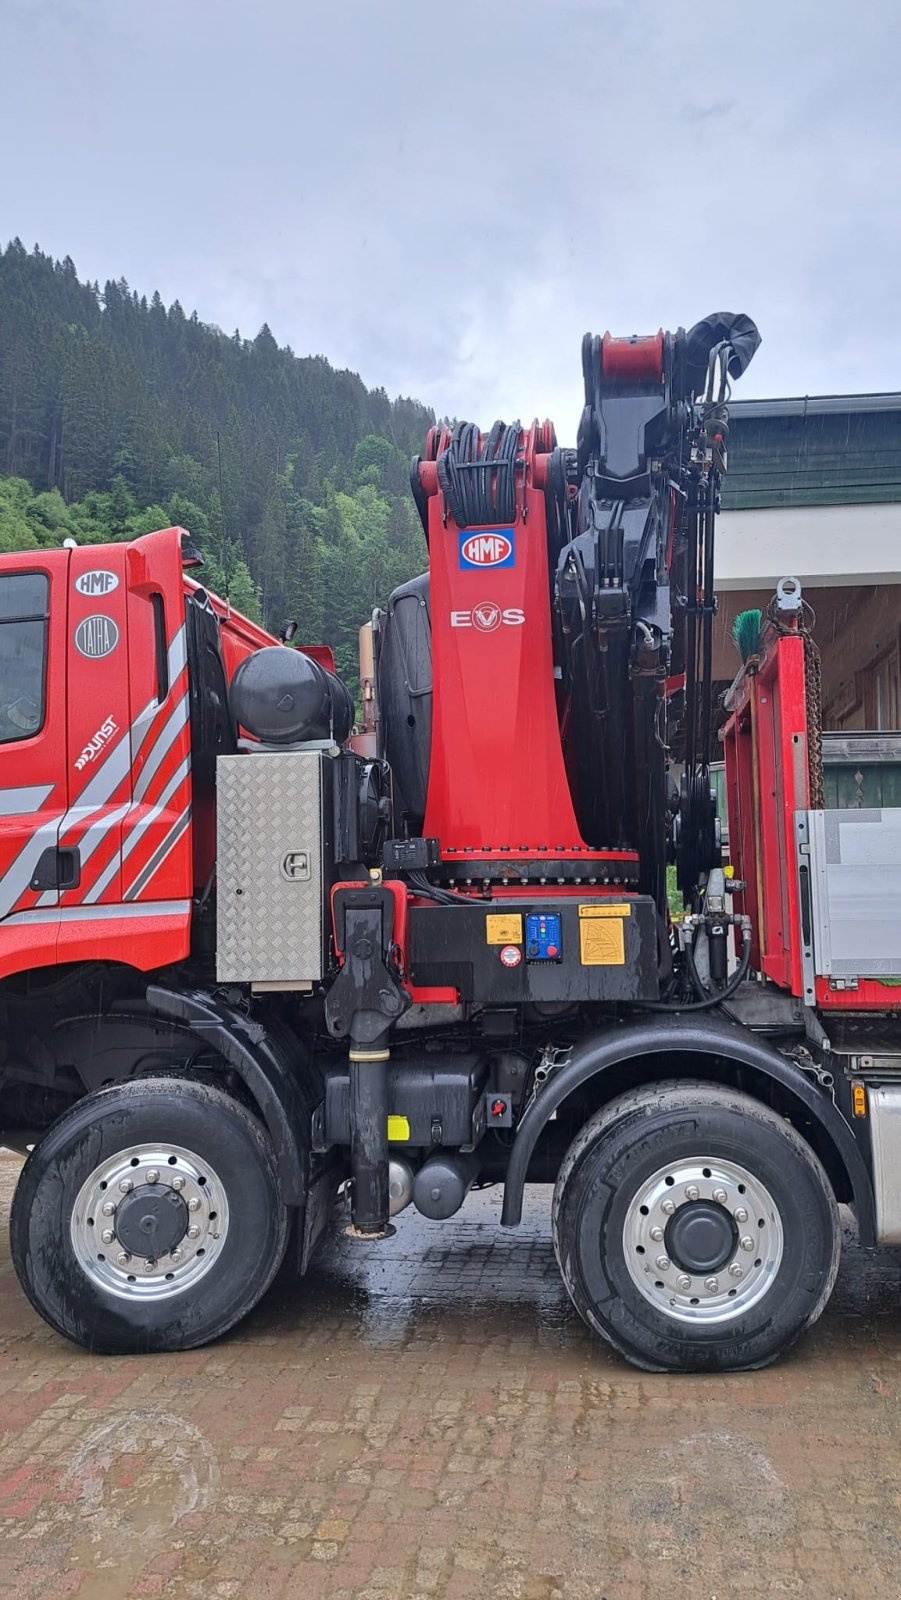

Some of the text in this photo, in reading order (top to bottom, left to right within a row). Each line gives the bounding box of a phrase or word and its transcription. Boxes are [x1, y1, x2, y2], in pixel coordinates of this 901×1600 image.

[468, 537, 505, 562] HMF
[80, 572, 114, 594] HMF
[450, 607, 526, 628] EVS
[83, 617, 110, 655] TATRA
[81, 713, 117, 761] DUNST
